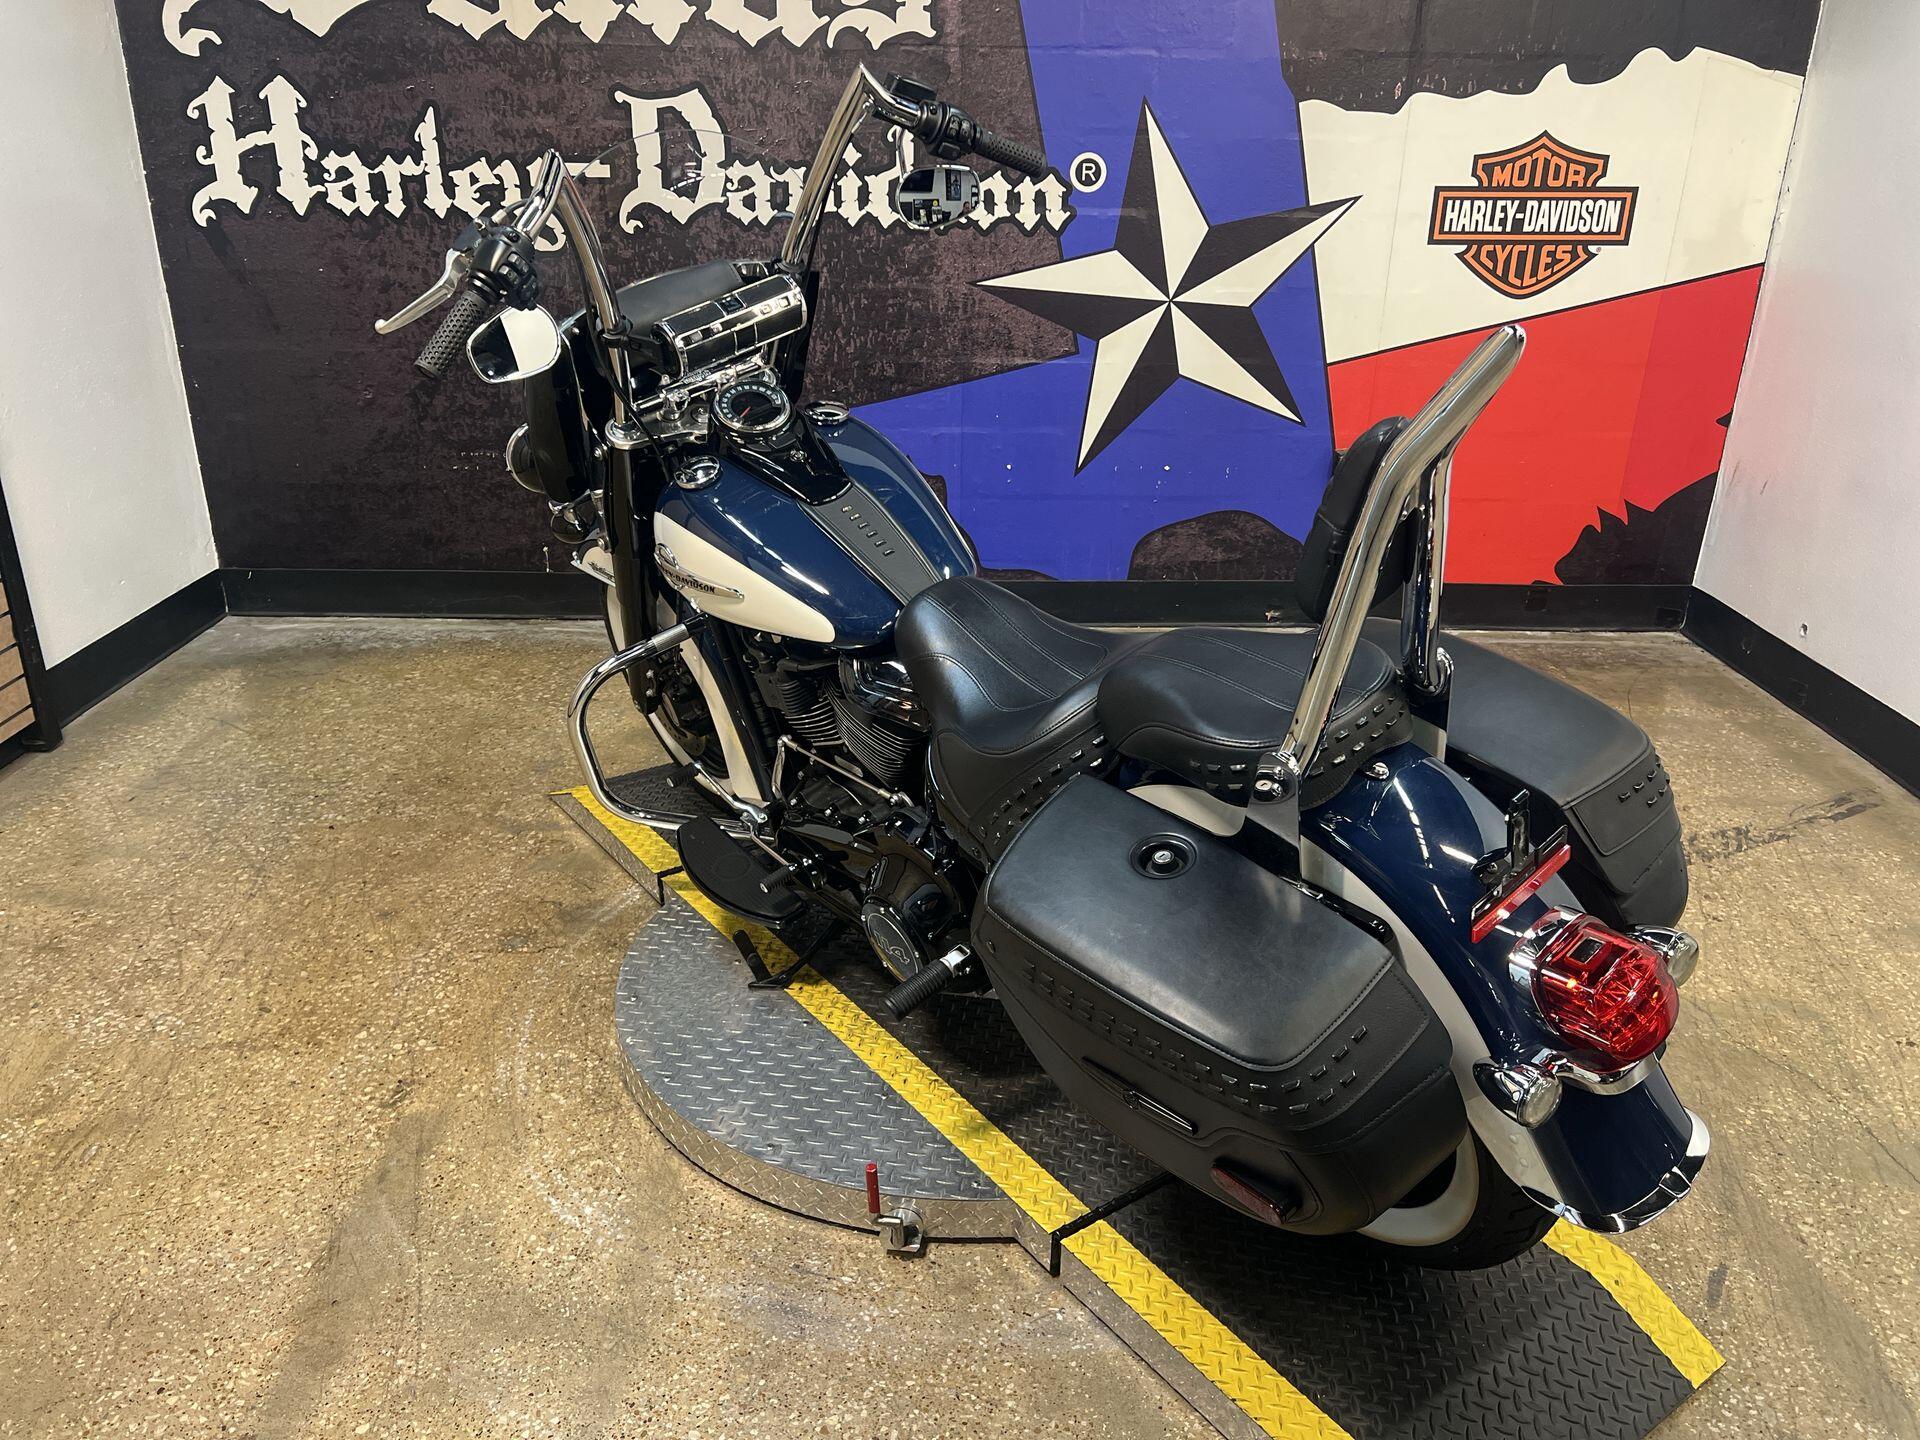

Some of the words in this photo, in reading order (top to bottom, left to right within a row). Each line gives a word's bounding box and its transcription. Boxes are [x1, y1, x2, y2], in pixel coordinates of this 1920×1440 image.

[1492, 148, 1587, 187] MOTOR
[1444, 199, 1622, 233] HARLEY-DAVIDSON
[1480, 244, 1572, 287] CYCLES
